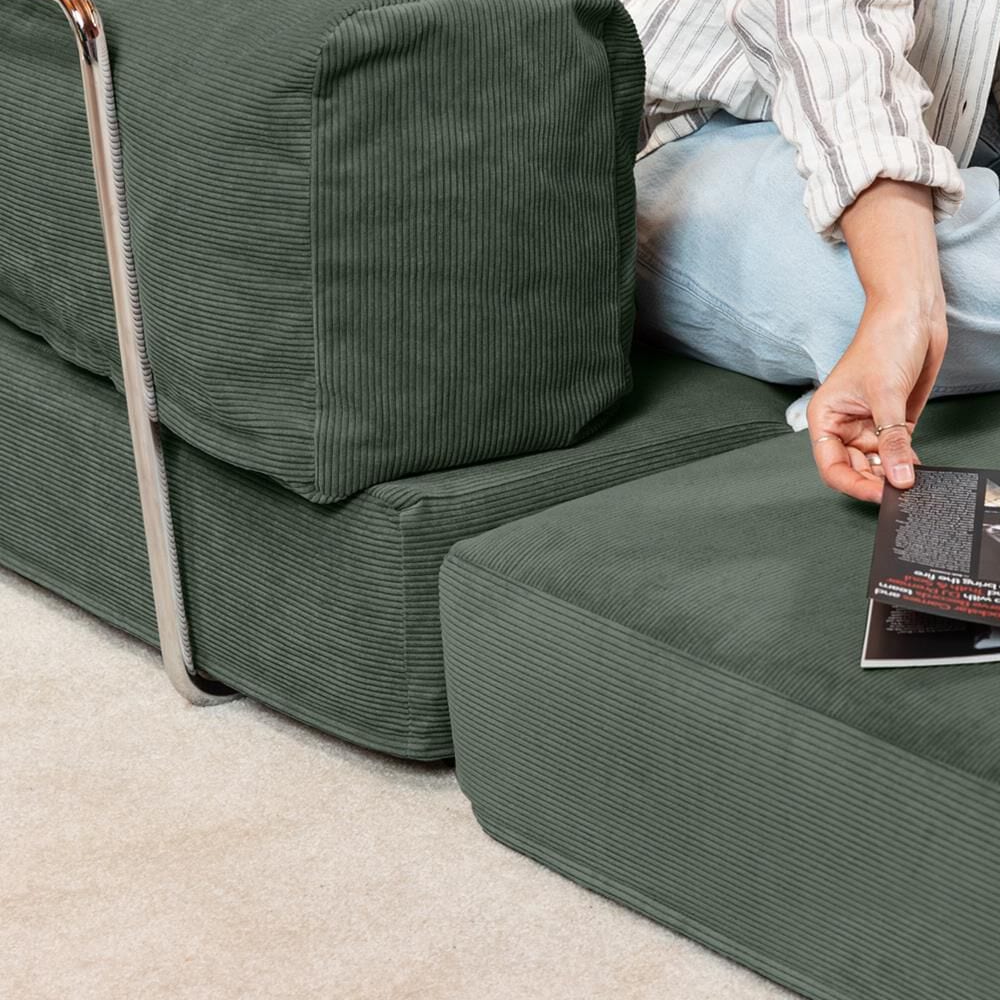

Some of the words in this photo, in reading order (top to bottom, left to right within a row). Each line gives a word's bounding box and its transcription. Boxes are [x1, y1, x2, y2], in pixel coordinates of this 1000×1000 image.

[912, 569, 936, 581] fire
[937, 575, 961, 585] the
[878, 581, 914, 596] team
[962, 576, 997, 590] bring
[874, 587, 902, 598] and
[962, 592, 993, 604] with
